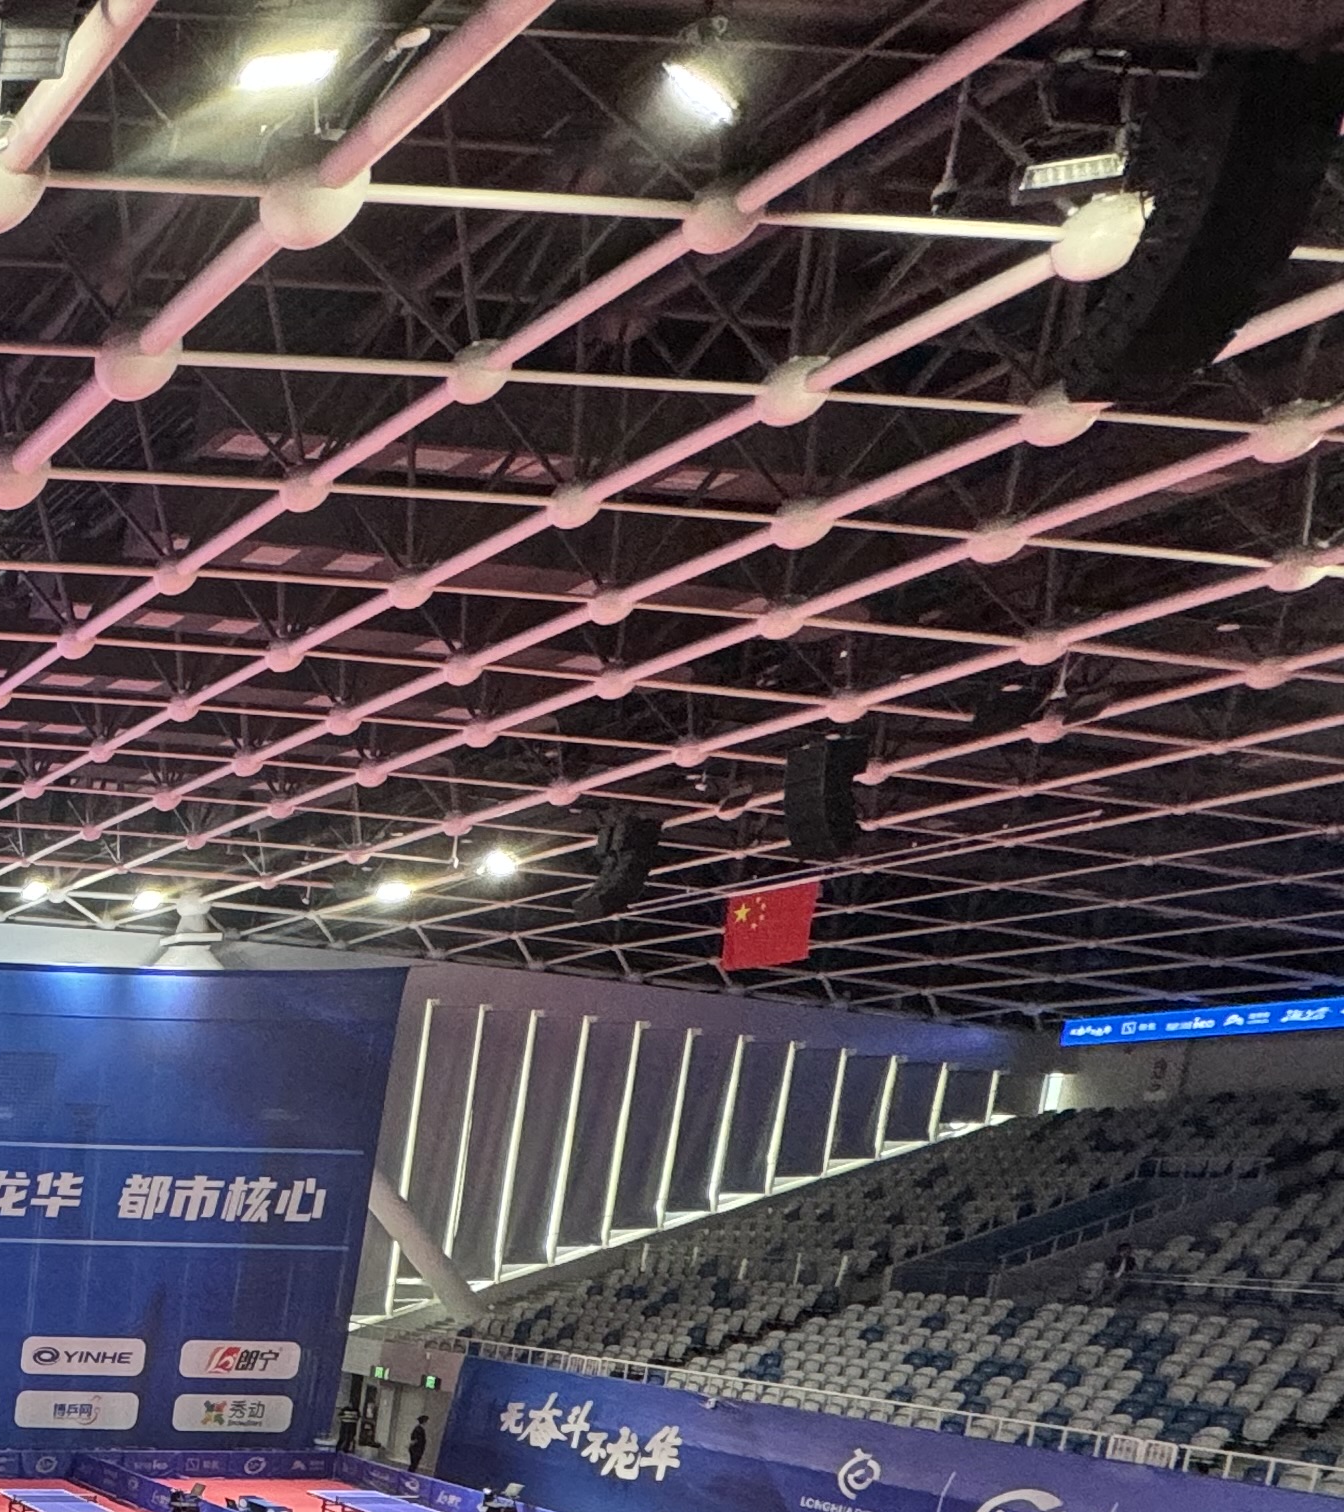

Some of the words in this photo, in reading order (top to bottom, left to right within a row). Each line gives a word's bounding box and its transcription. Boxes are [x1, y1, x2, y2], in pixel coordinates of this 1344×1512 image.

[117, 1173, 324, 1223] 都市核心
[64, 1350, 134, 1364] YINHE
[235, 1349, 279, 1372] 朗宁
[228, 1400, 265, 1419] 秀动
